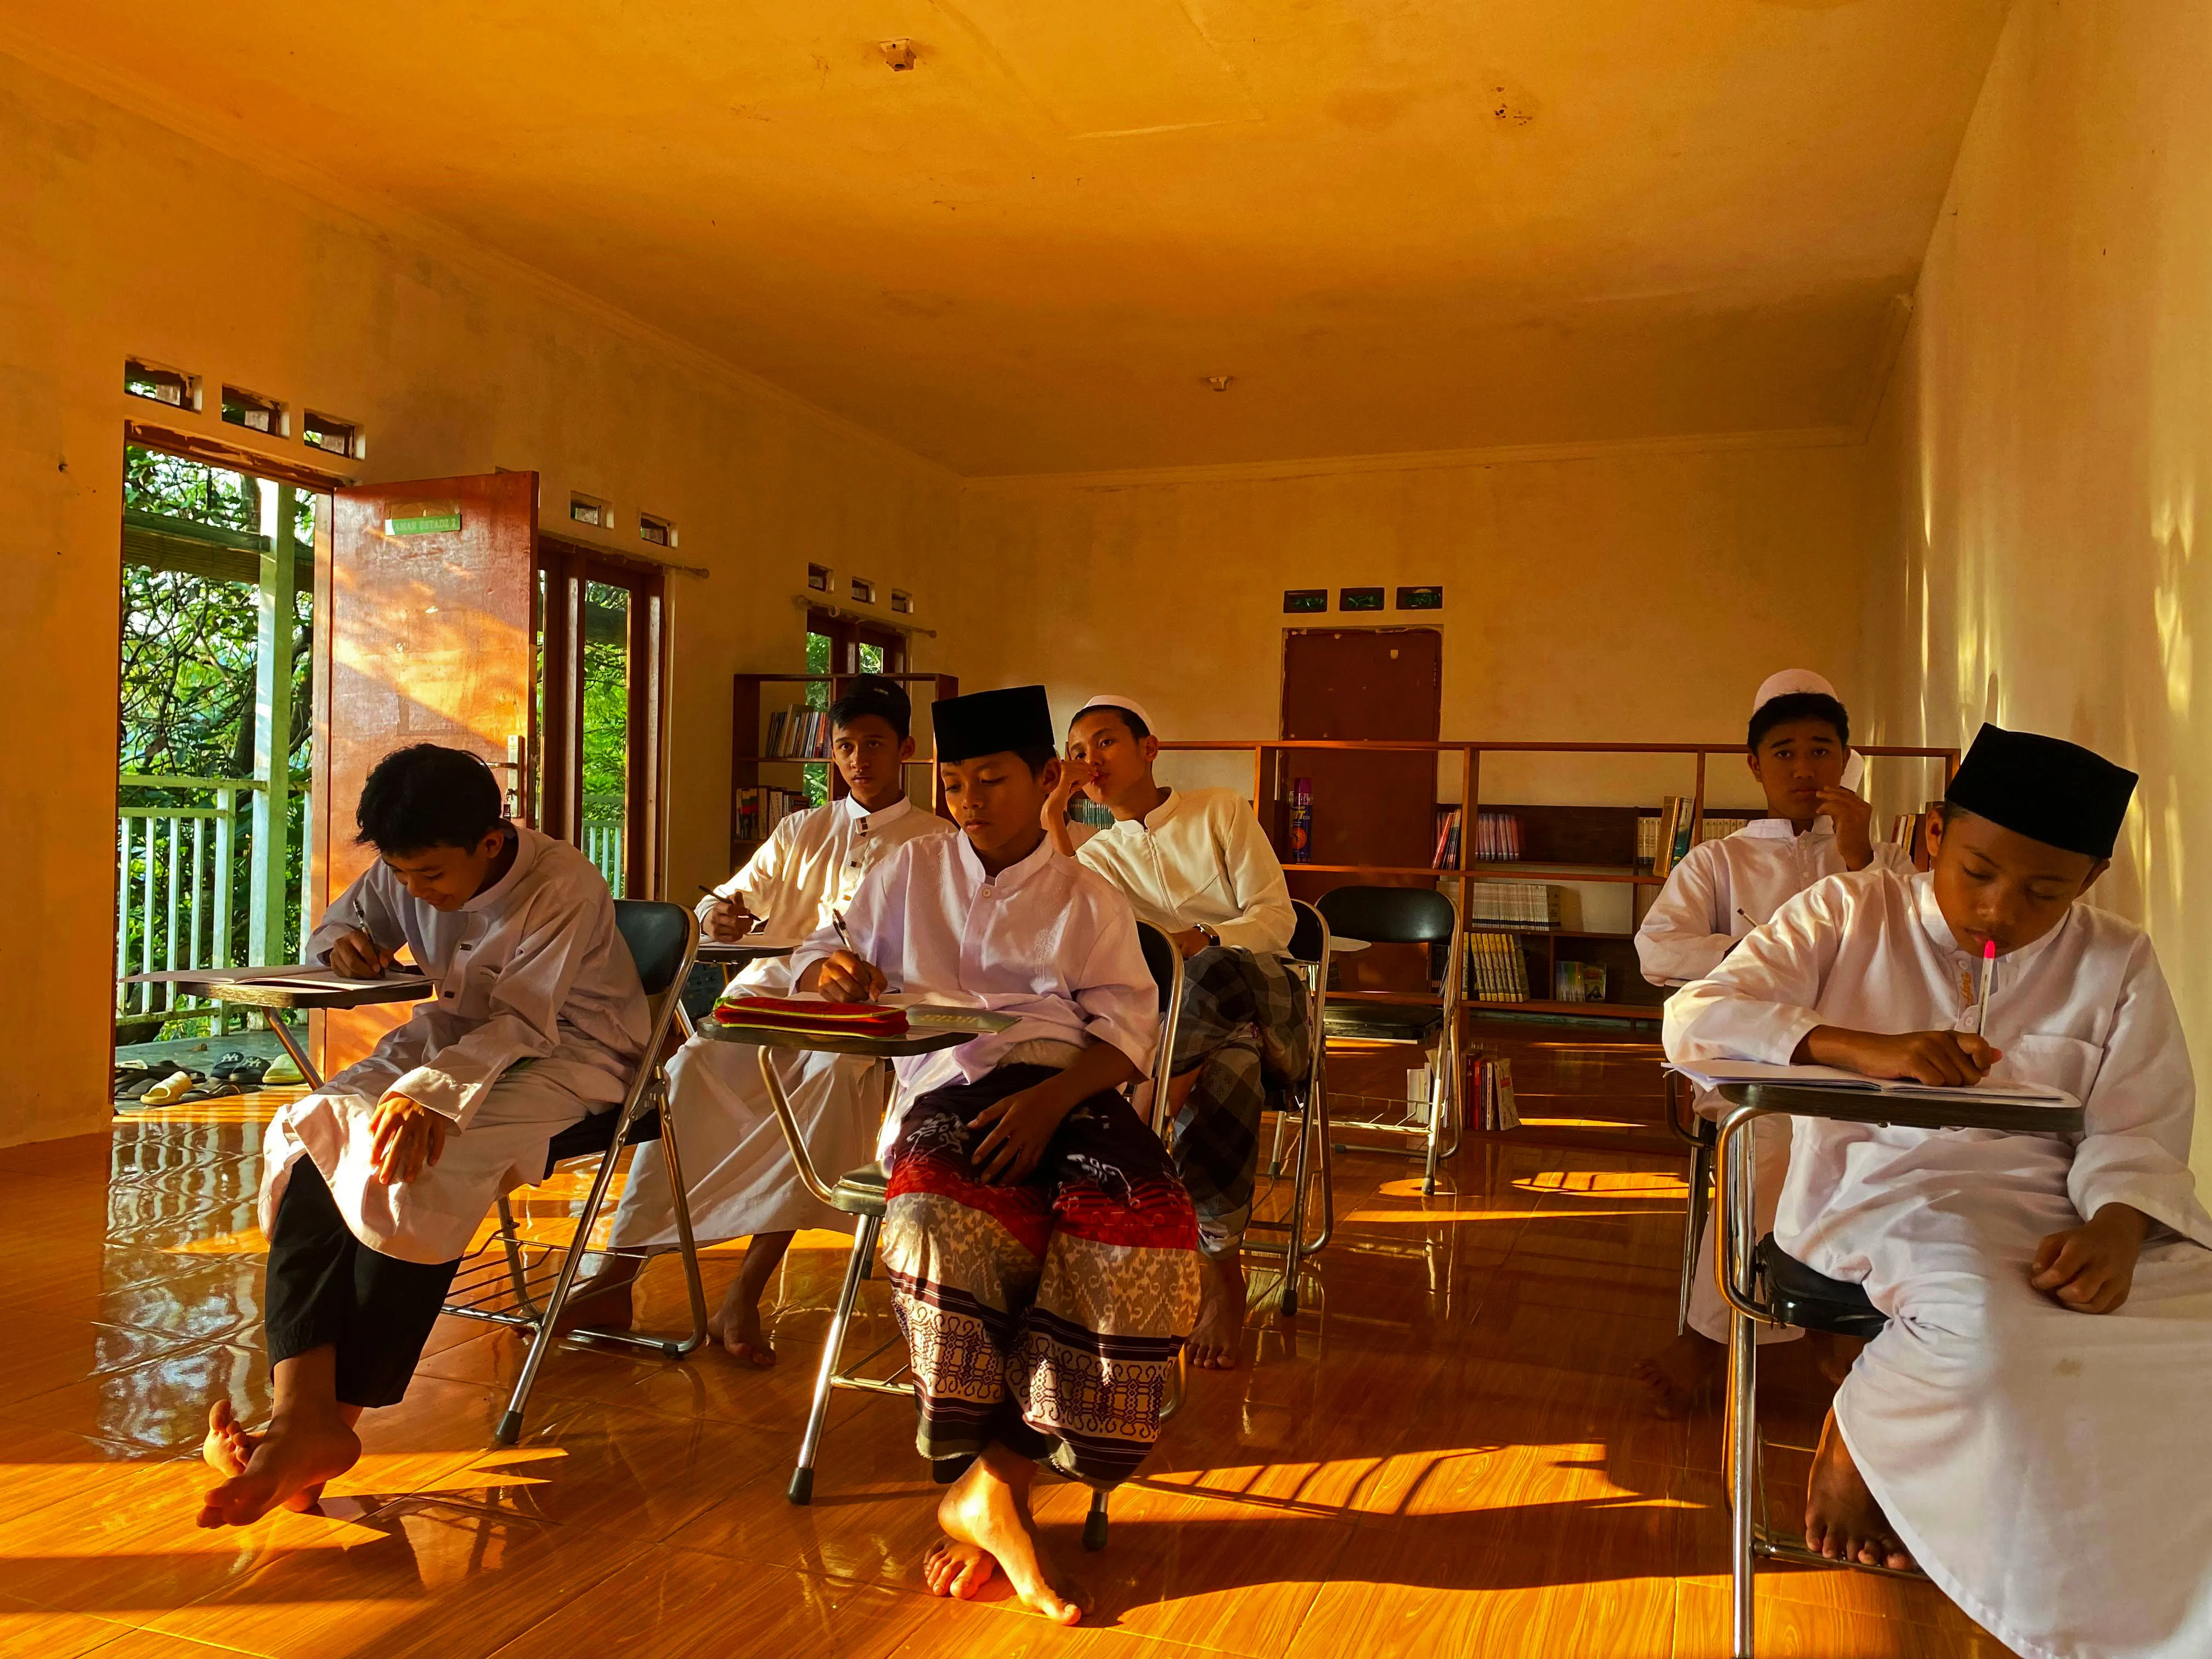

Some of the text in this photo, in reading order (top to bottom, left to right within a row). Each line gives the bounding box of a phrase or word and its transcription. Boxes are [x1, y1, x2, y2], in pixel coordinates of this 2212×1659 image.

[393, 522, 417, 532] AMAR
[419, 518, 449, 530] USTADZ
[221, 1053, 239, 1062] NY
[242, 1057, 262, 1067] NY
